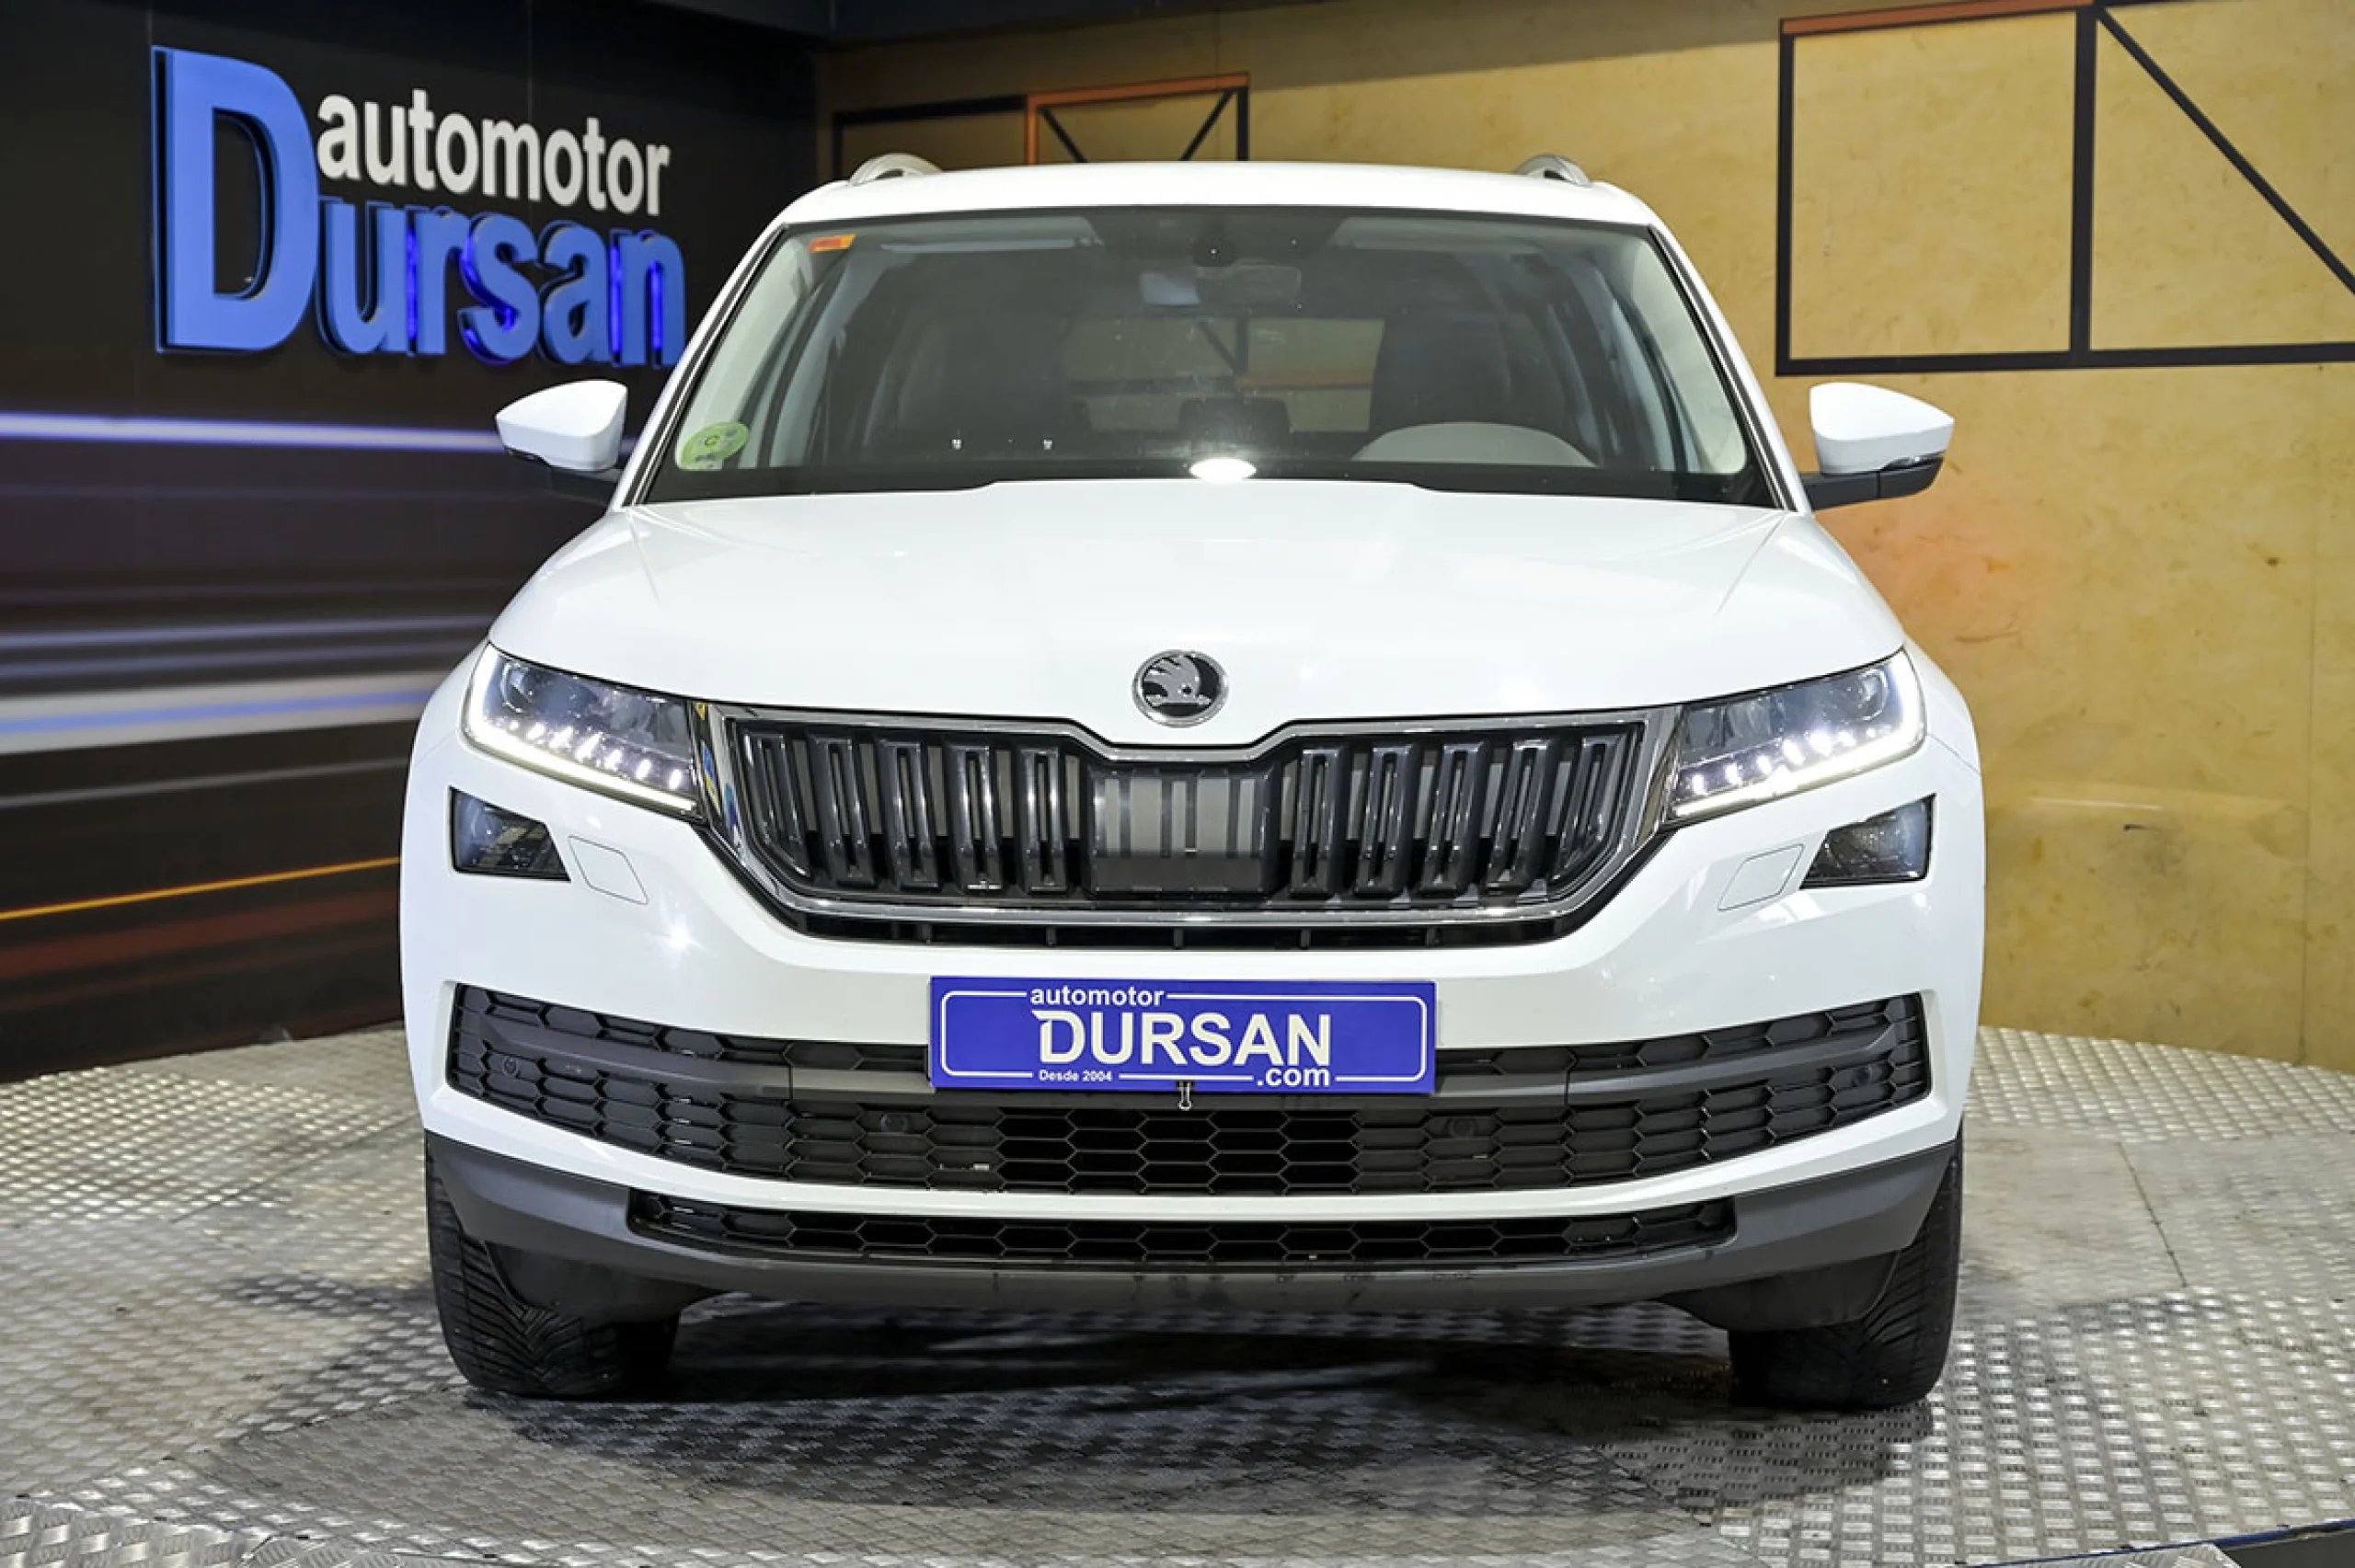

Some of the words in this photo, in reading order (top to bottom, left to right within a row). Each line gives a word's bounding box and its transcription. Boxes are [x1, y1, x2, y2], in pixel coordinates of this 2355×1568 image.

[316, 89, 670, 216] automotor
[151, 45, 686, 367] Dursan
[1030, 985, 1165, 1006] automotor
[1031, 1010, 1331, 1066] DURSAN
[1039, 1070, 1079, 1082] Desde
[1083, 1070, 1112, 1082] 2004
[1257, 1068, 1330, 1087] .com
